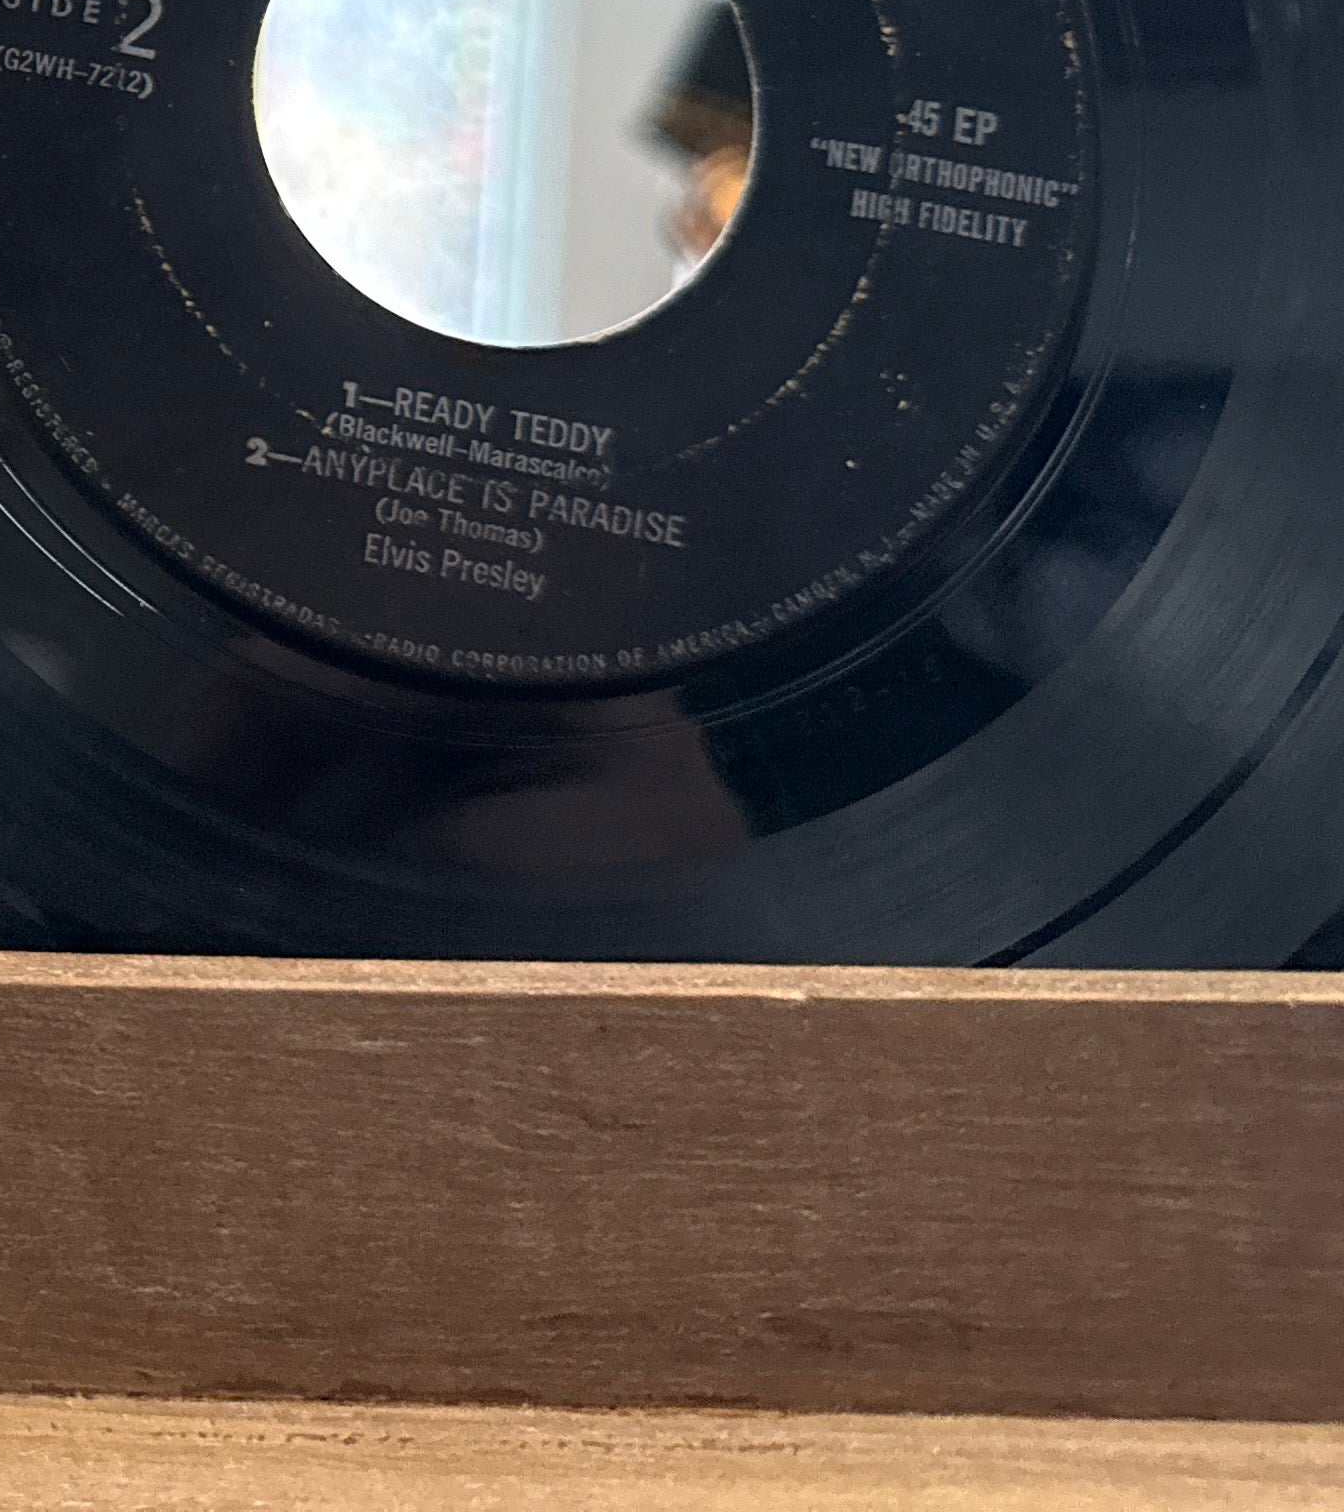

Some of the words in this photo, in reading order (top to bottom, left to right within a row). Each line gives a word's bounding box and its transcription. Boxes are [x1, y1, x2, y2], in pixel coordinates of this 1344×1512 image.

[904, 99, 942, 137] 45
[953, 106, 999, 146] EP
[849, 189, 912, 226] HIGH
[918, 200, 1028, 248] FIDELITY
[510, 409, 612, 456] TEDDY
[375, 496, 429, 527] (Joe
[438, 508, 544, 554] Thomas)
[481, 480, 514, 514] IS
[529, 490, 686, 548] PARADISE
[364, 533, 431, 575] Elvis
[440, 548, 545, 602] Presley
